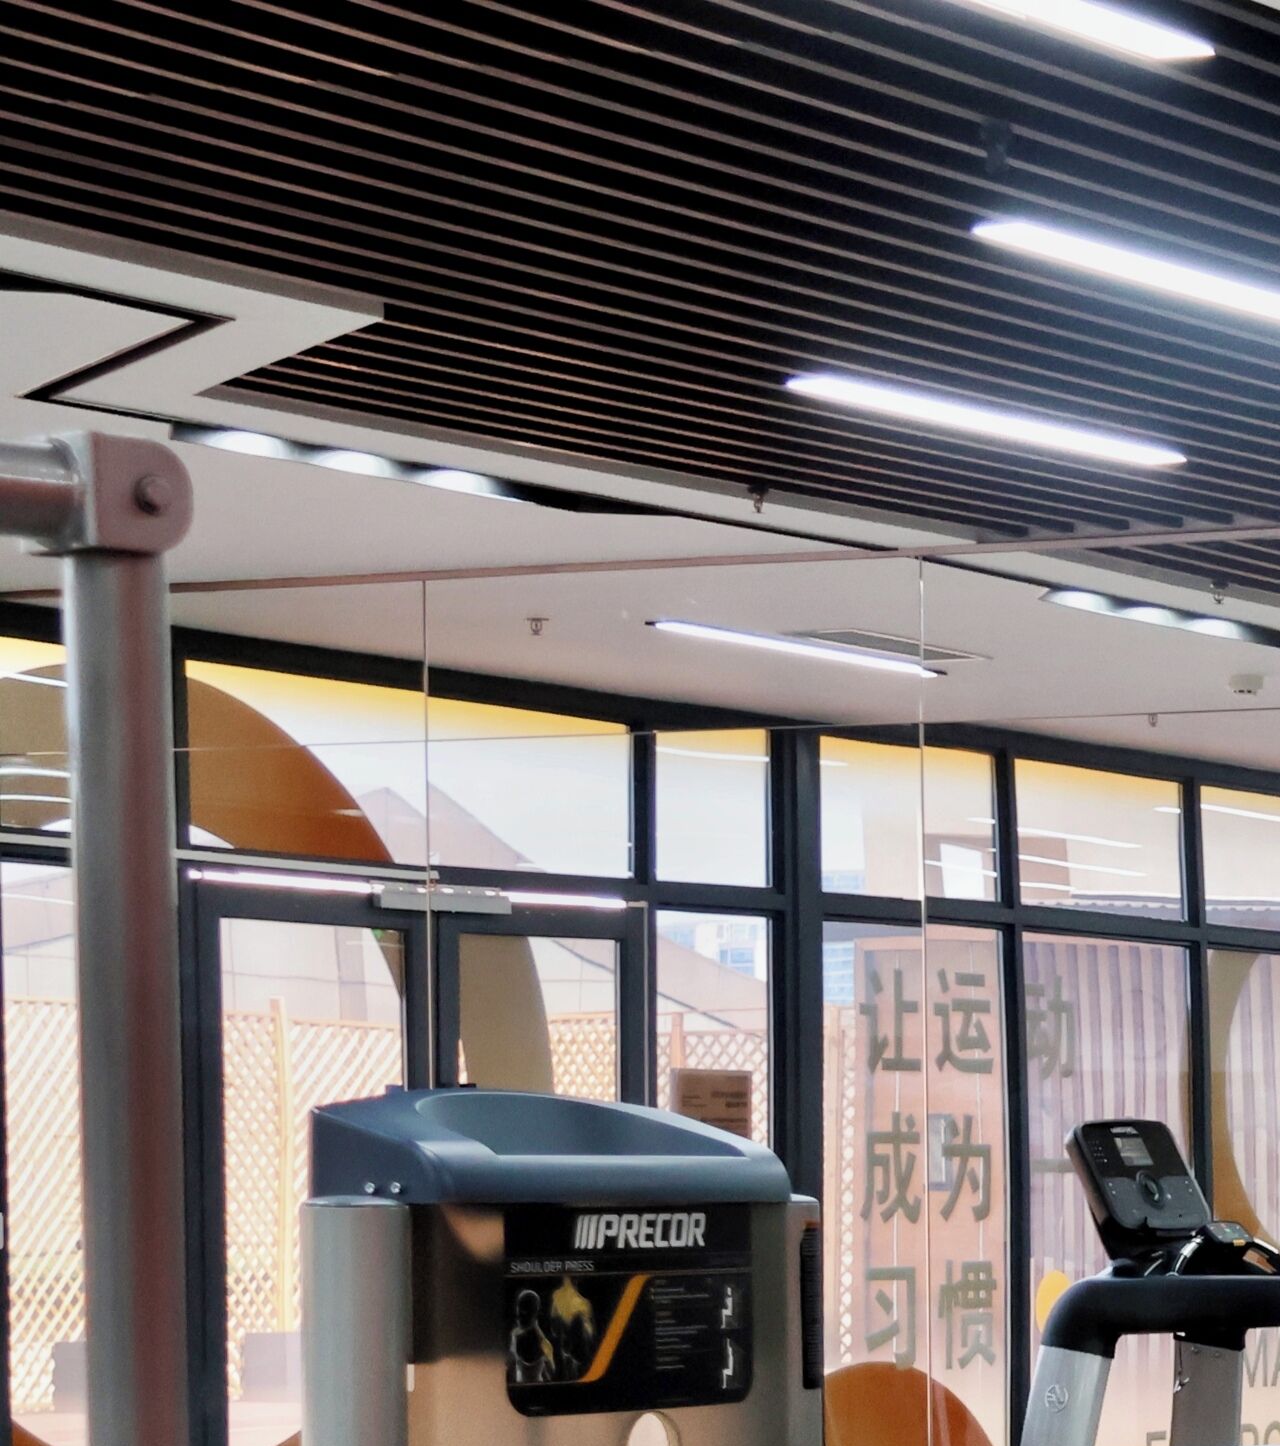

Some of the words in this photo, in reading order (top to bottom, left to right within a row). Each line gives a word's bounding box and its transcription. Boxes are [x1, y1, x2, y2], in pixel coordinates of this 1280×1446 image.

[596, 1212, 706, 1250] PRECOR
[510, 1260, 563, 1274] SHOULDER
[564, 1259, 595, 1272] PRESS
[863, 1258, 998, 1371] 习惯
